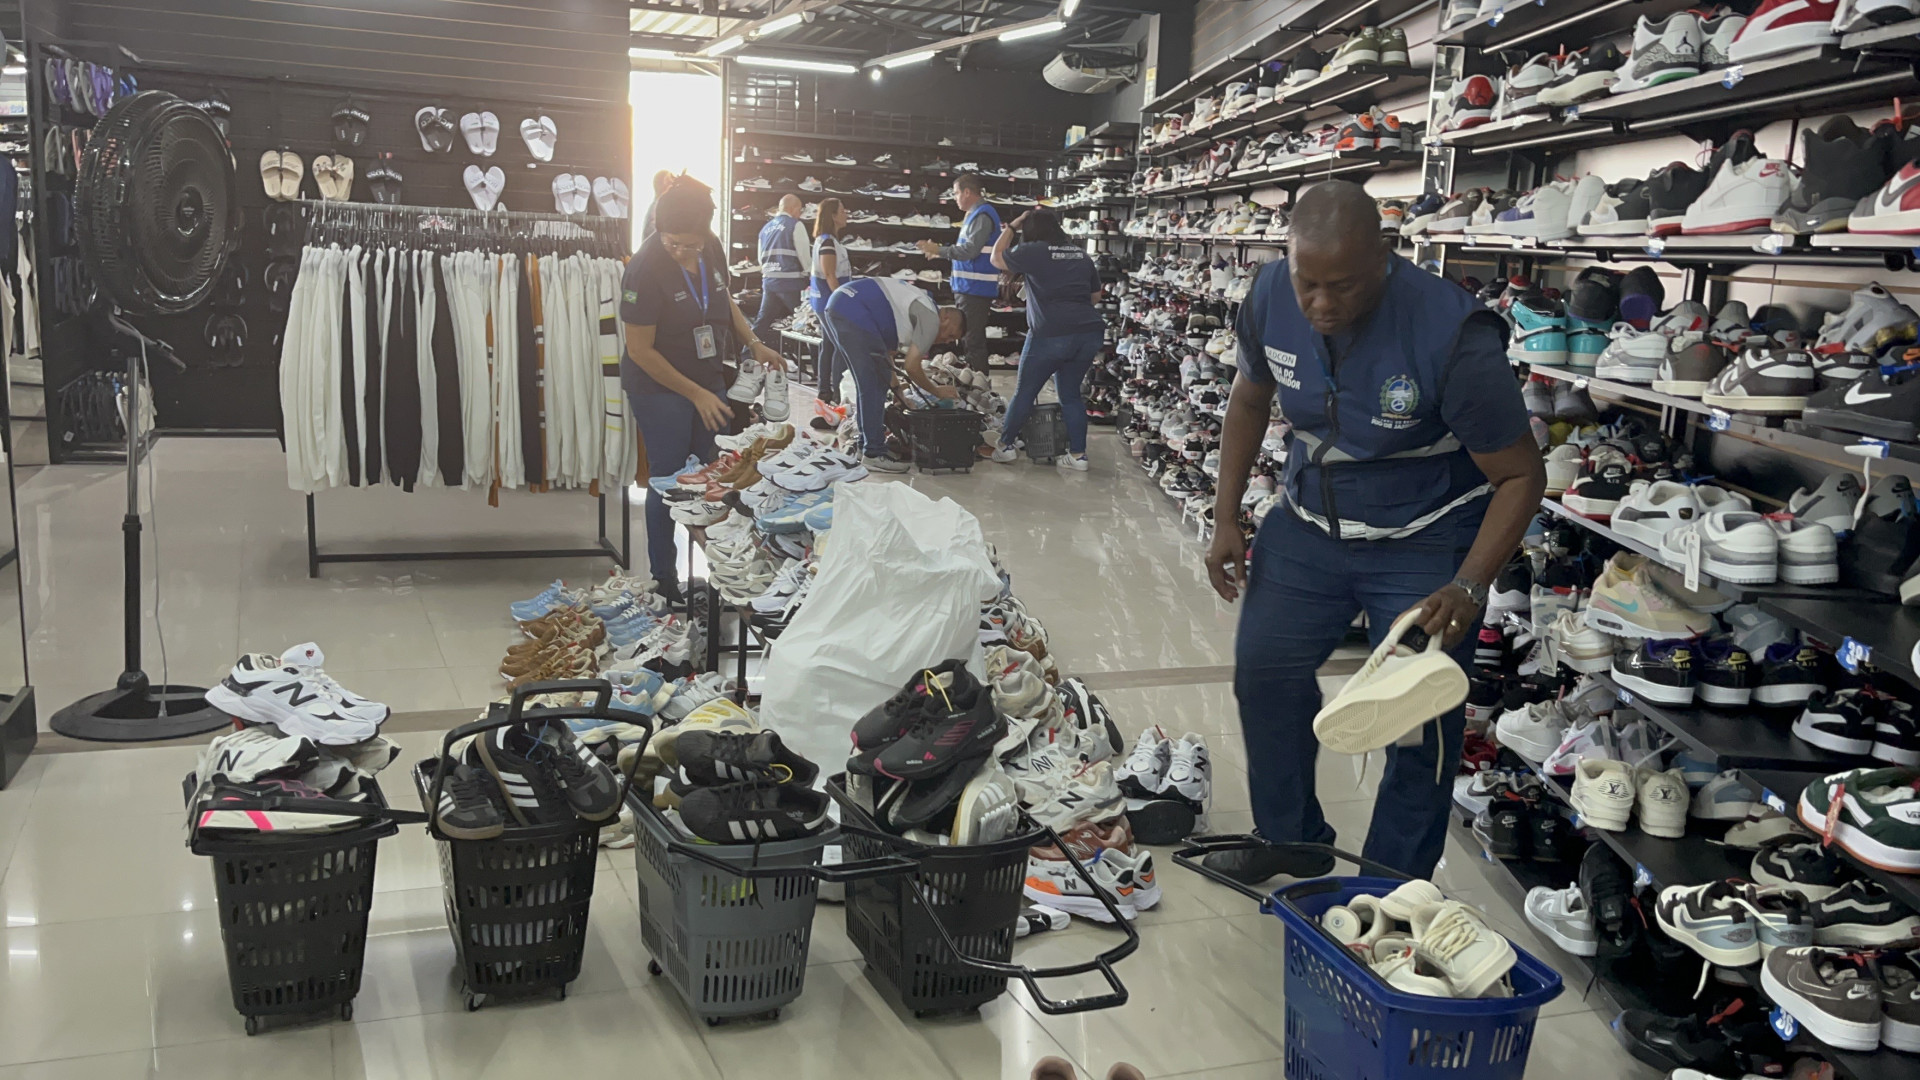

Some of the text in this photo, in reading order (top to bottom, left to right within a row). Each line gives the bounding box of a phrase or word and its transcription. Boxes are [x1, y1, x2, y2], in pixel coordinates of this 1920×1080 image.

[1786, 352, 1807, 362] NIKE
[1850, 354, 1871, 364] NIKE
[1284, 368, 1294, 379] DO
[810, 456, 836, 471] N
[273, 682, 318, 707] N
[217, 750, 244, 772] N
[1031, 755, 1055, 774] N
[1194, 756, 1208, 772] N
[1058, 790, 1084, 809] N
[1064, 878, 1077, 890] N
[1853, 984, 1871, 992] NIKE
[1775, 1007, 1794, 1037] 36
